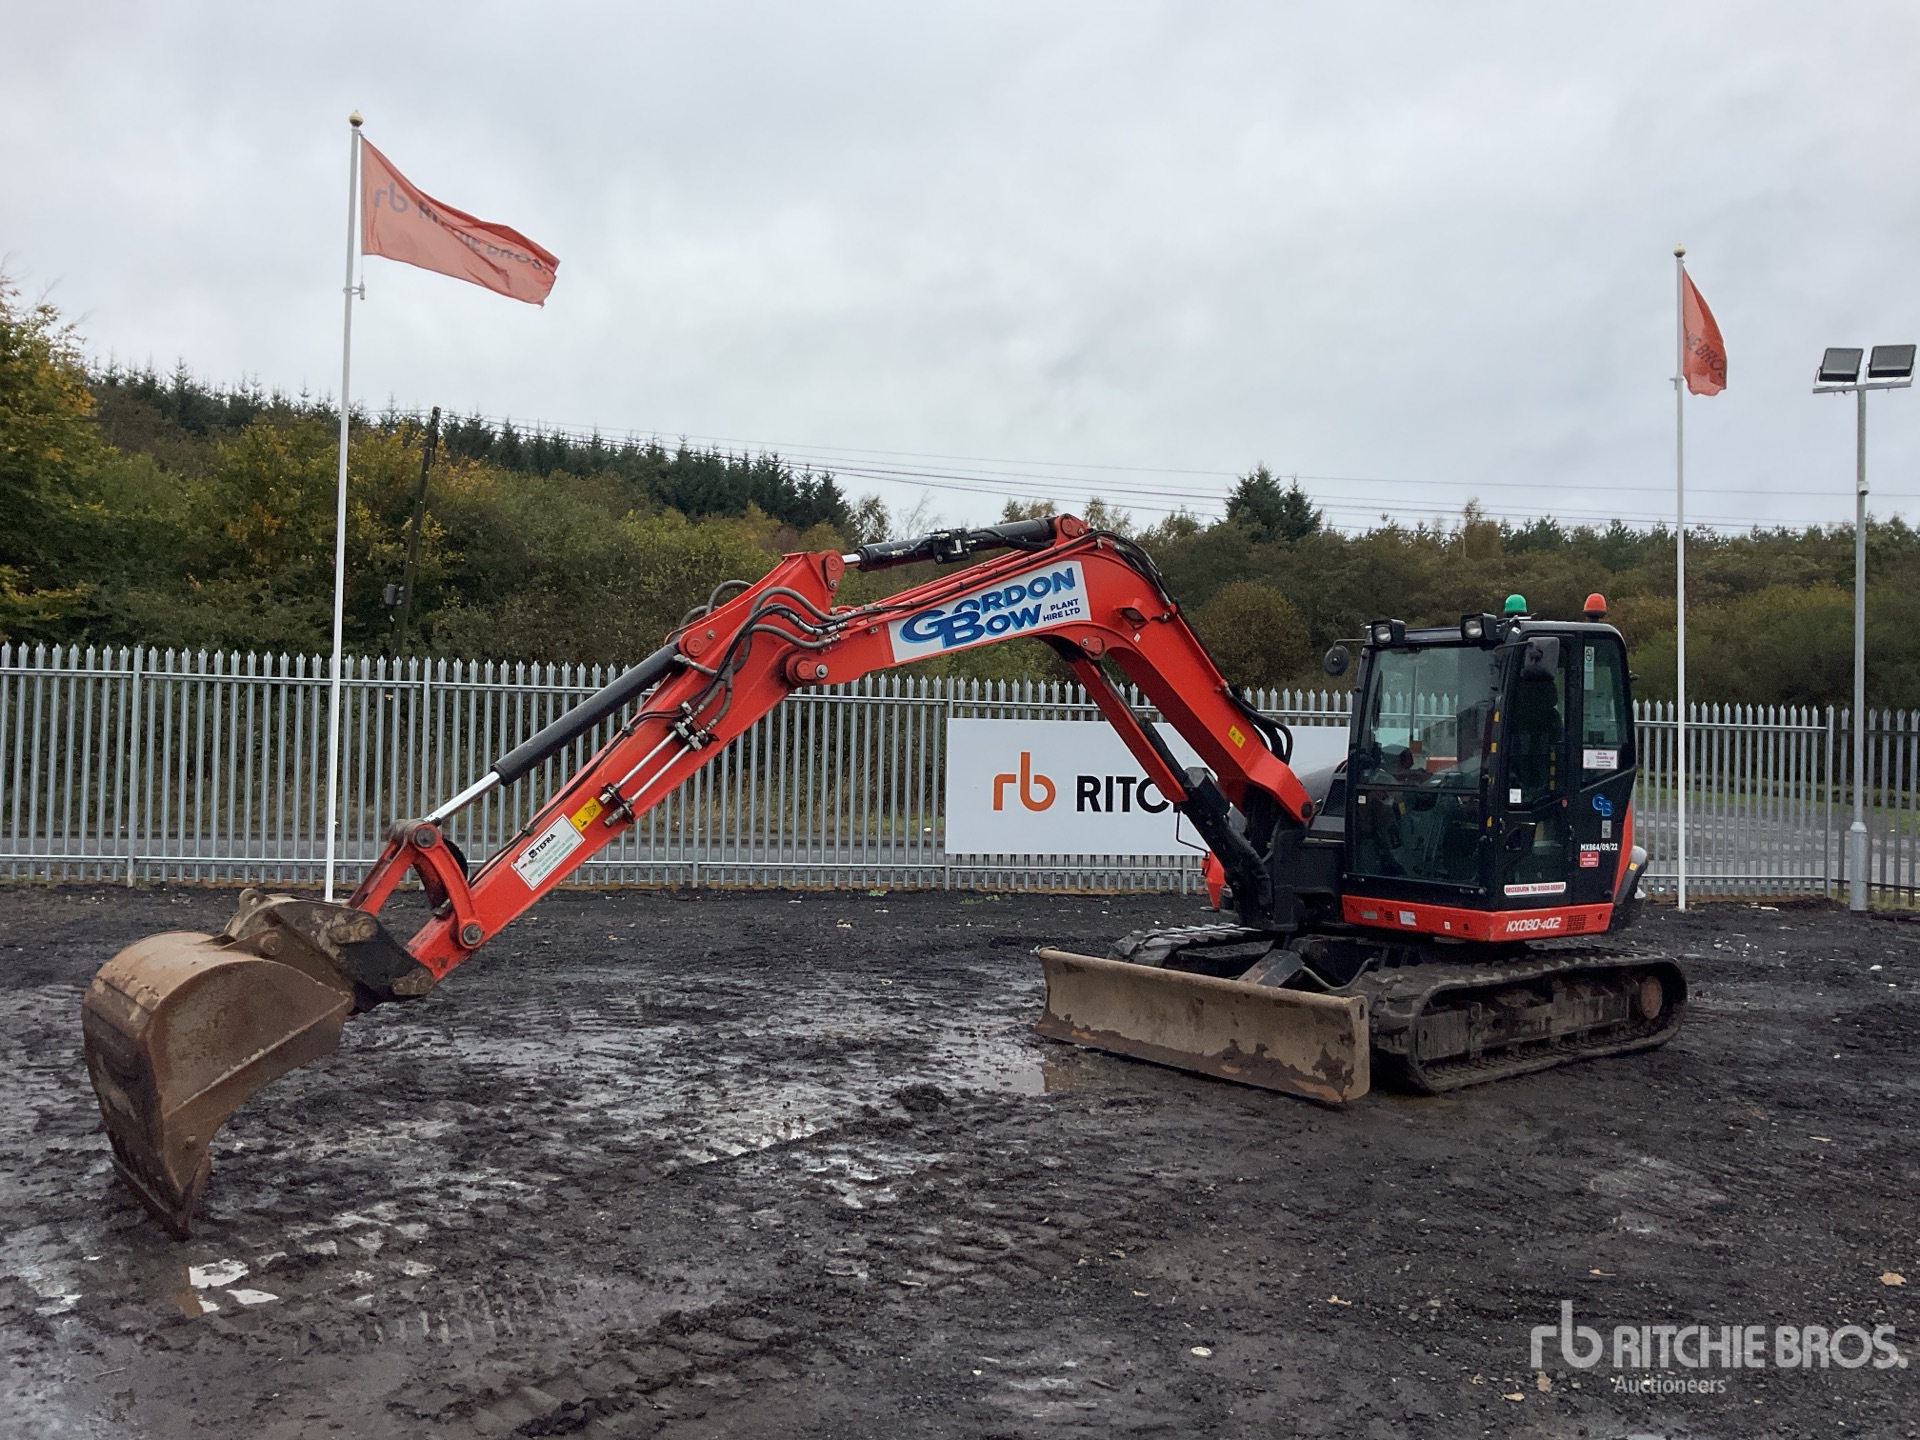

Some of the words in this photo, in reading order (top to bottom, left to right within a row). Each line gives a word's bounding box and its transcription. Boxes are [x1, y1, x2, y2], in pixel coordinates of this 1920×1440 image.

[374, 181, 408, 213] rb
[899, 567, 1077, 643] GORDON
[1042, 610, 1063, 622] HIRE
[1065, 606, 1081, 617] LTD
[1050, 598, 1079, 612] PLANT
[942, 603, 1042, 649] BOW
[993, 751, 1056, 812] rb
[1076, 775, 1181, 813] RITC
[1592, 793, 1612, 816] GB
[535, 833, 556, 853] TEFRA
